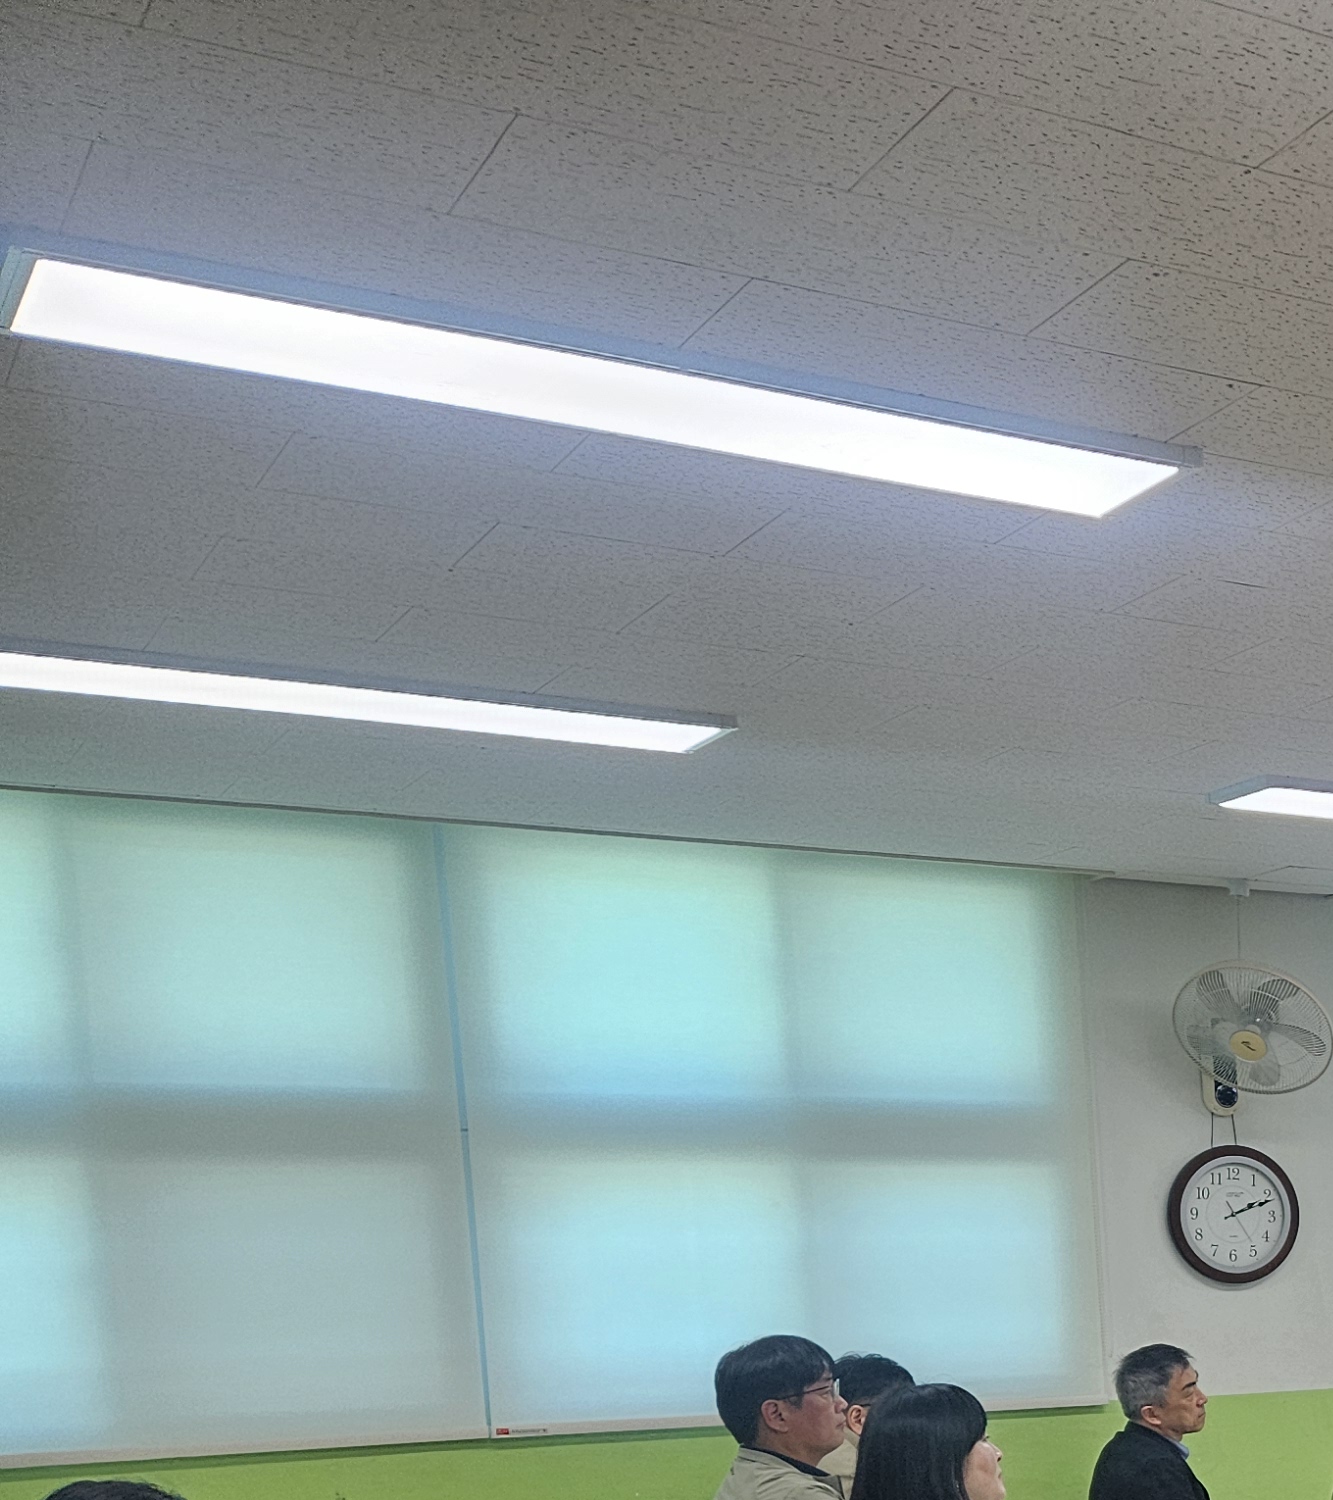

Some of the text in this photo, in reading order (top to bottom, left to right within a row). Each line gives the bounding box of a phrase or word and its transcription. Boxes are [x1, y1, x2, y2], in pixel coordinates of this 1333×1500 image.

[1210, 1172, 1222, 1185] 11
[1226, 1167, 1240, 1181] 12
[1251, 1174, 1256, 1187] 1
[1196, 1186, 1210, 1200] 10
[1264, 1189, 1272, 1199] 2
[1190, 1207, 1198, 1220] 9
[1268, 1210, 1276, 1223] 3
[1194, 1228, 1203, 1241] 8
[1261, 1230, 1270, 1242] 4
[1210, 1244, 1219, 1257] 7
[1229, 1249, 1238, 1262] 6
[1249, 1245, 1257, 1257] 5
